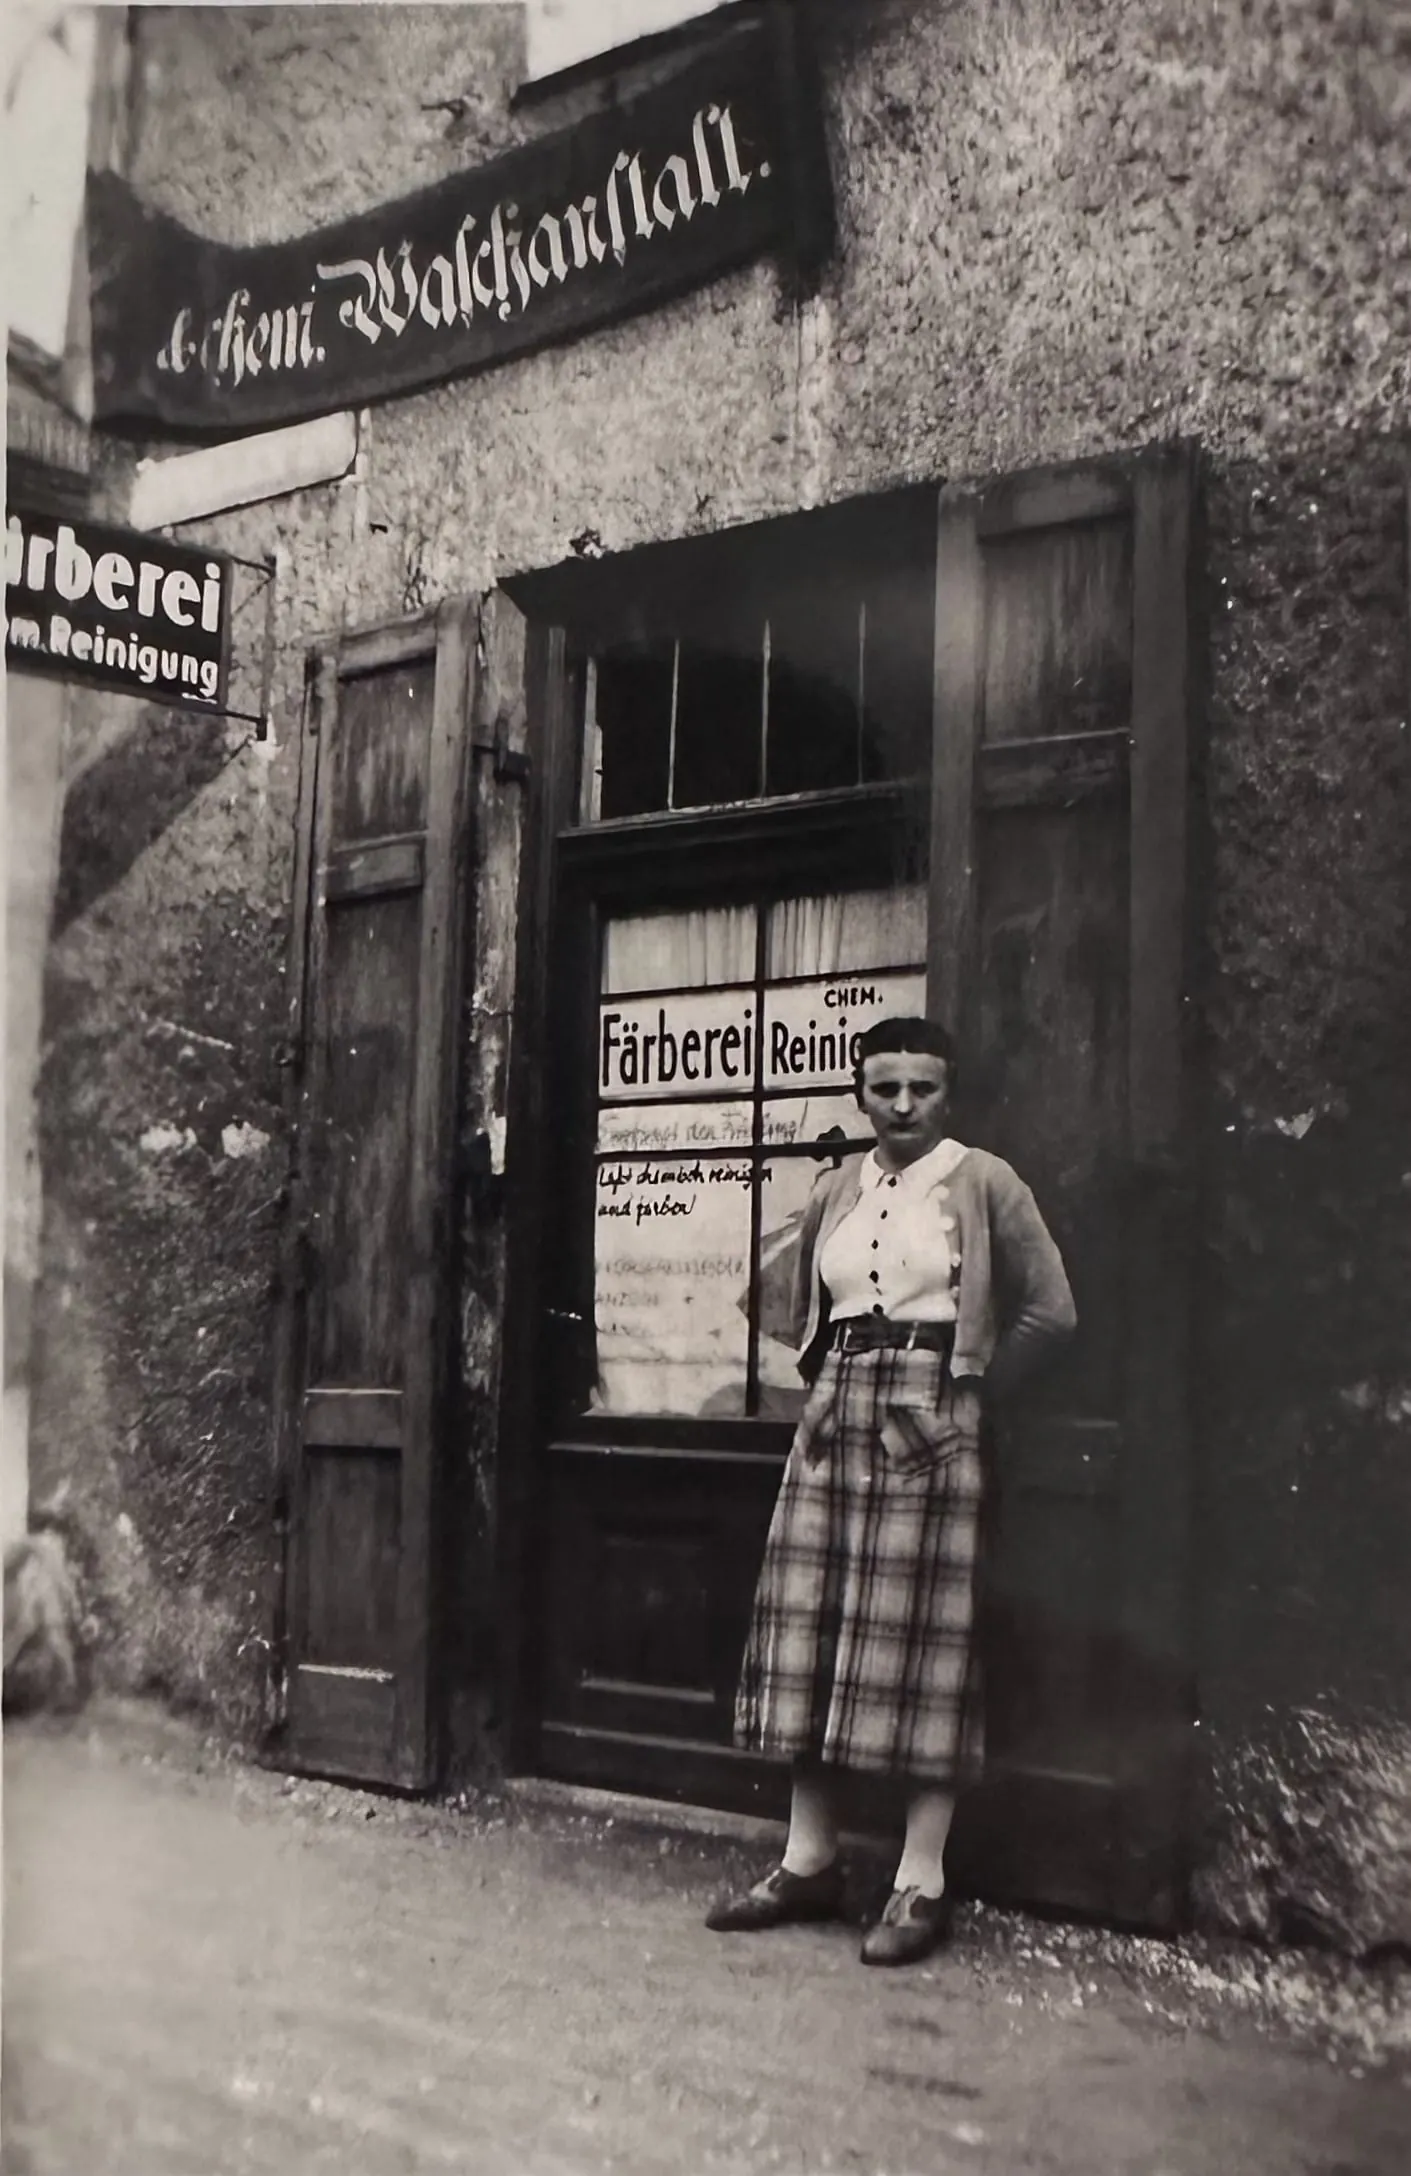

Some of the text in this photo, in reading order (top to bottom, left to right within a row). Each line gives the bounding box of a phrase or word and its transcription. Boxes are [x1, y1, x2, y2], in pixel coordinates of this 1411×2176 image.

[50, 614, 219, 698] Reinigung
[823, 986, 884, 1008] CHEM.
[602, 1009, 753, 1087] Färberei
